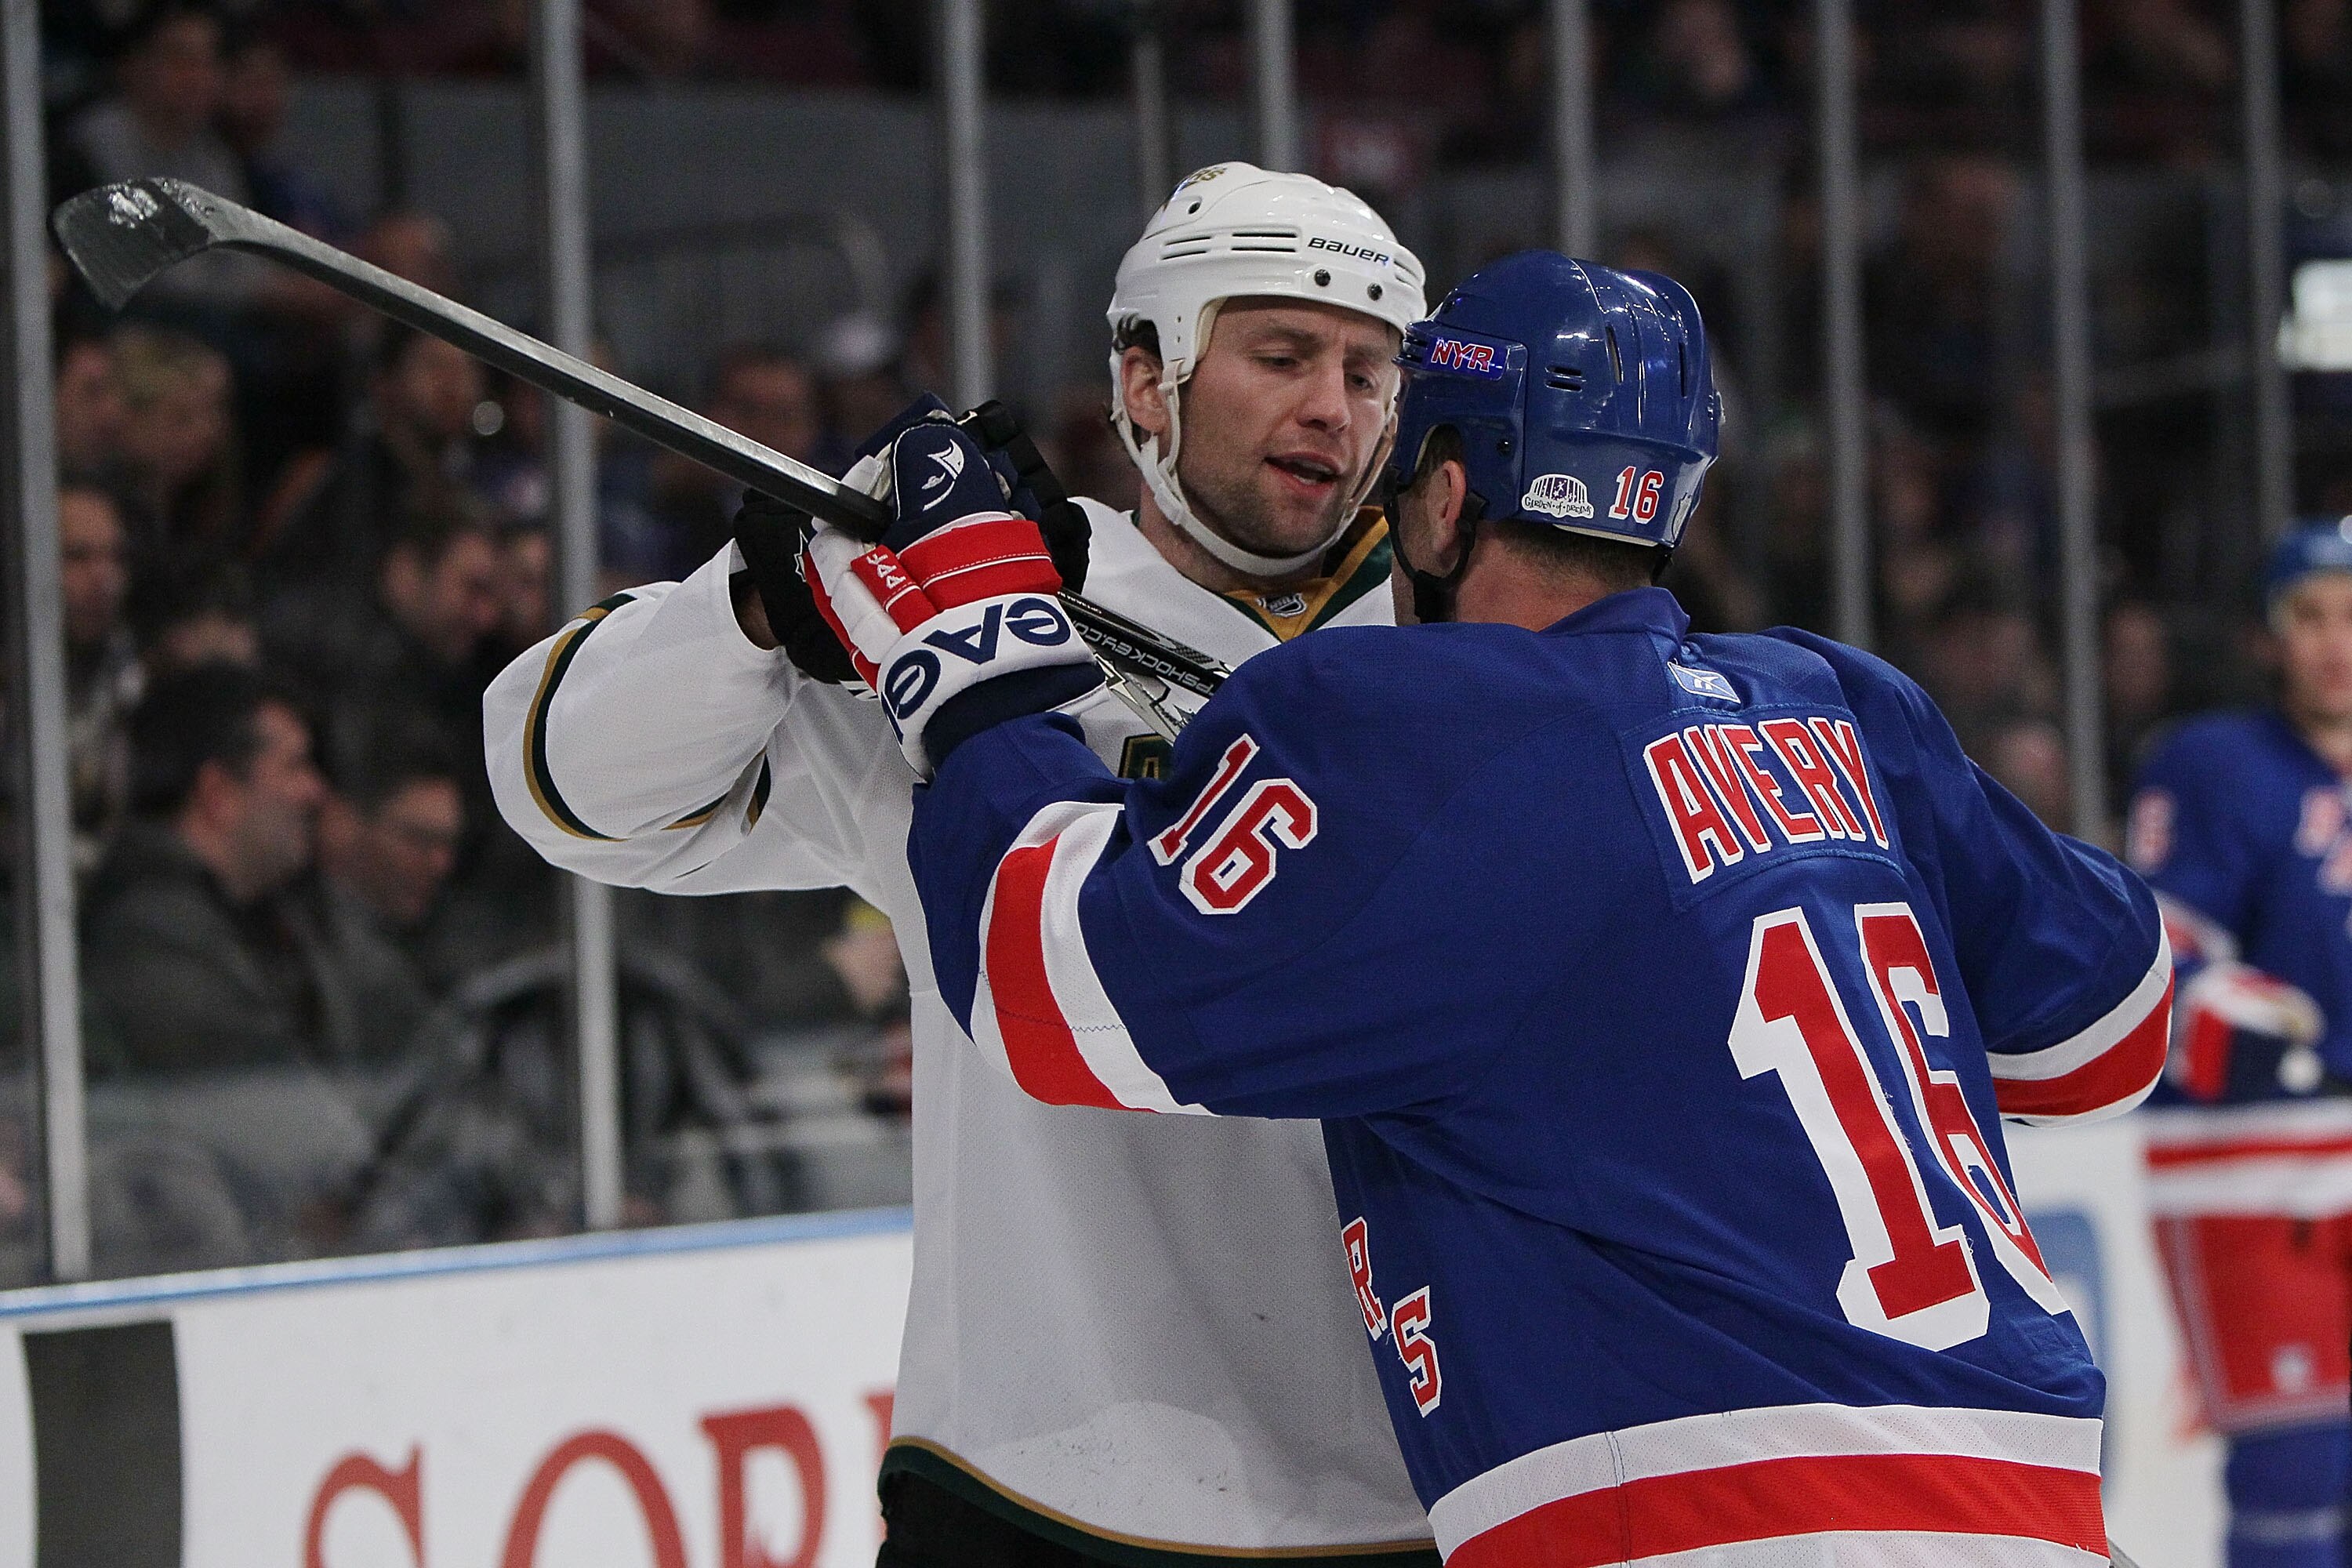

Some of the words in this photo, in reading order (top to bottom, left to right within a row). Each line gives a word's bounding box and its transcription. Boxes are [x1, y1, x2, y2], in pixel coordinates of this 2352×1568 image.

[1431, 337, 1494, 372] NYR
[1609, 466, 1664, 524] 16
[1072, 619, 1214, 696] PSHOCKEY.CO
[1147, 733, 1318, 914] 16
[1643, 717, 1889, 884] AVERY
[1728, 902, 2071, 1352] 16
